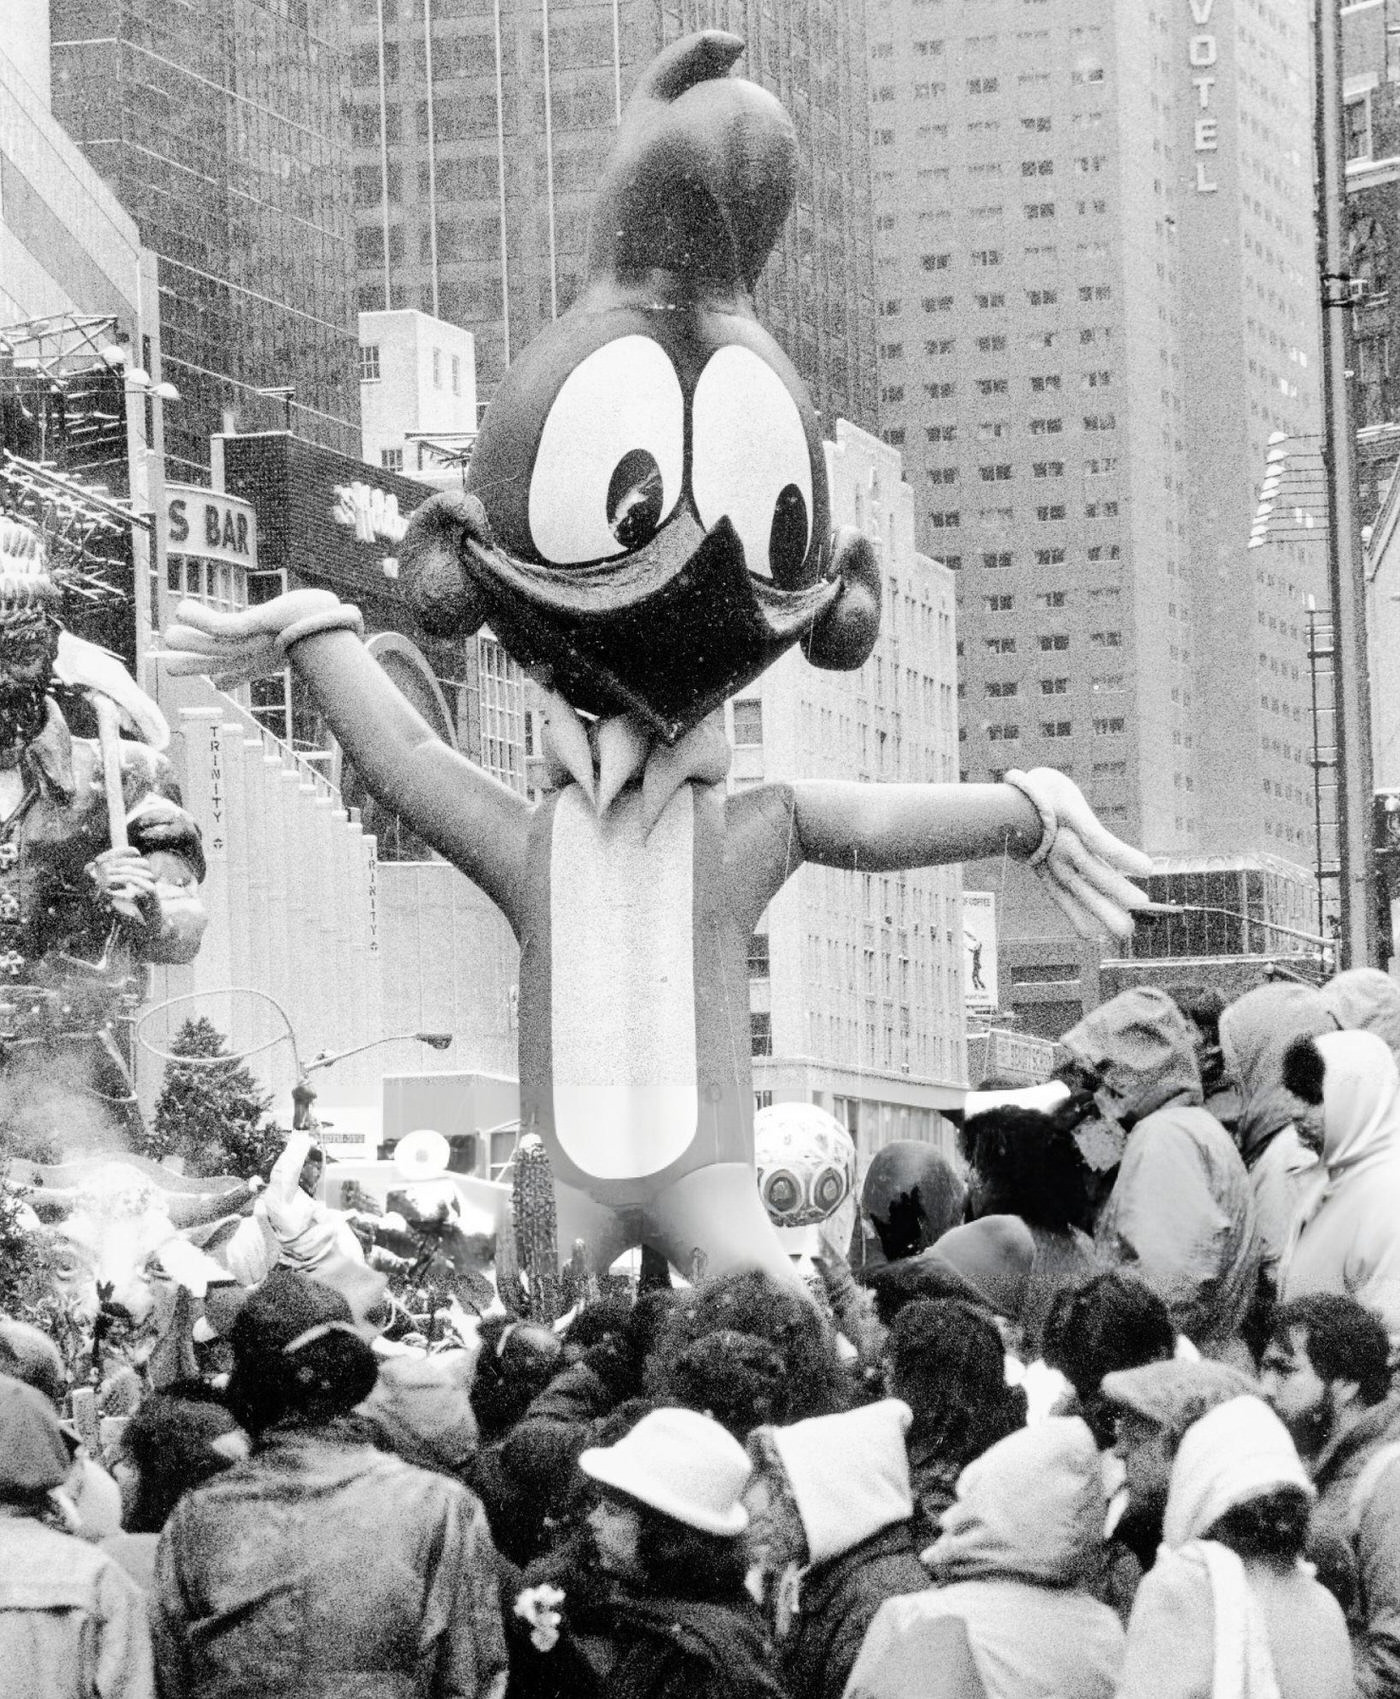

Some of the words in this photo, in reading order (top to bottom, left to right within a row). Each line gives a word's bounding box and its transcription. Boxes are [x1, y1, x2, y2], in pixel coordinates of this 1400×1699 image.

[1190, 0, 1217, 191] VOTEL
[168, 500, 190, 542] S
[205, 504, 250, 556] BAR
[209, 726, 221, 823] TRINITY
[367, 846, 377, 935] TRINITY
